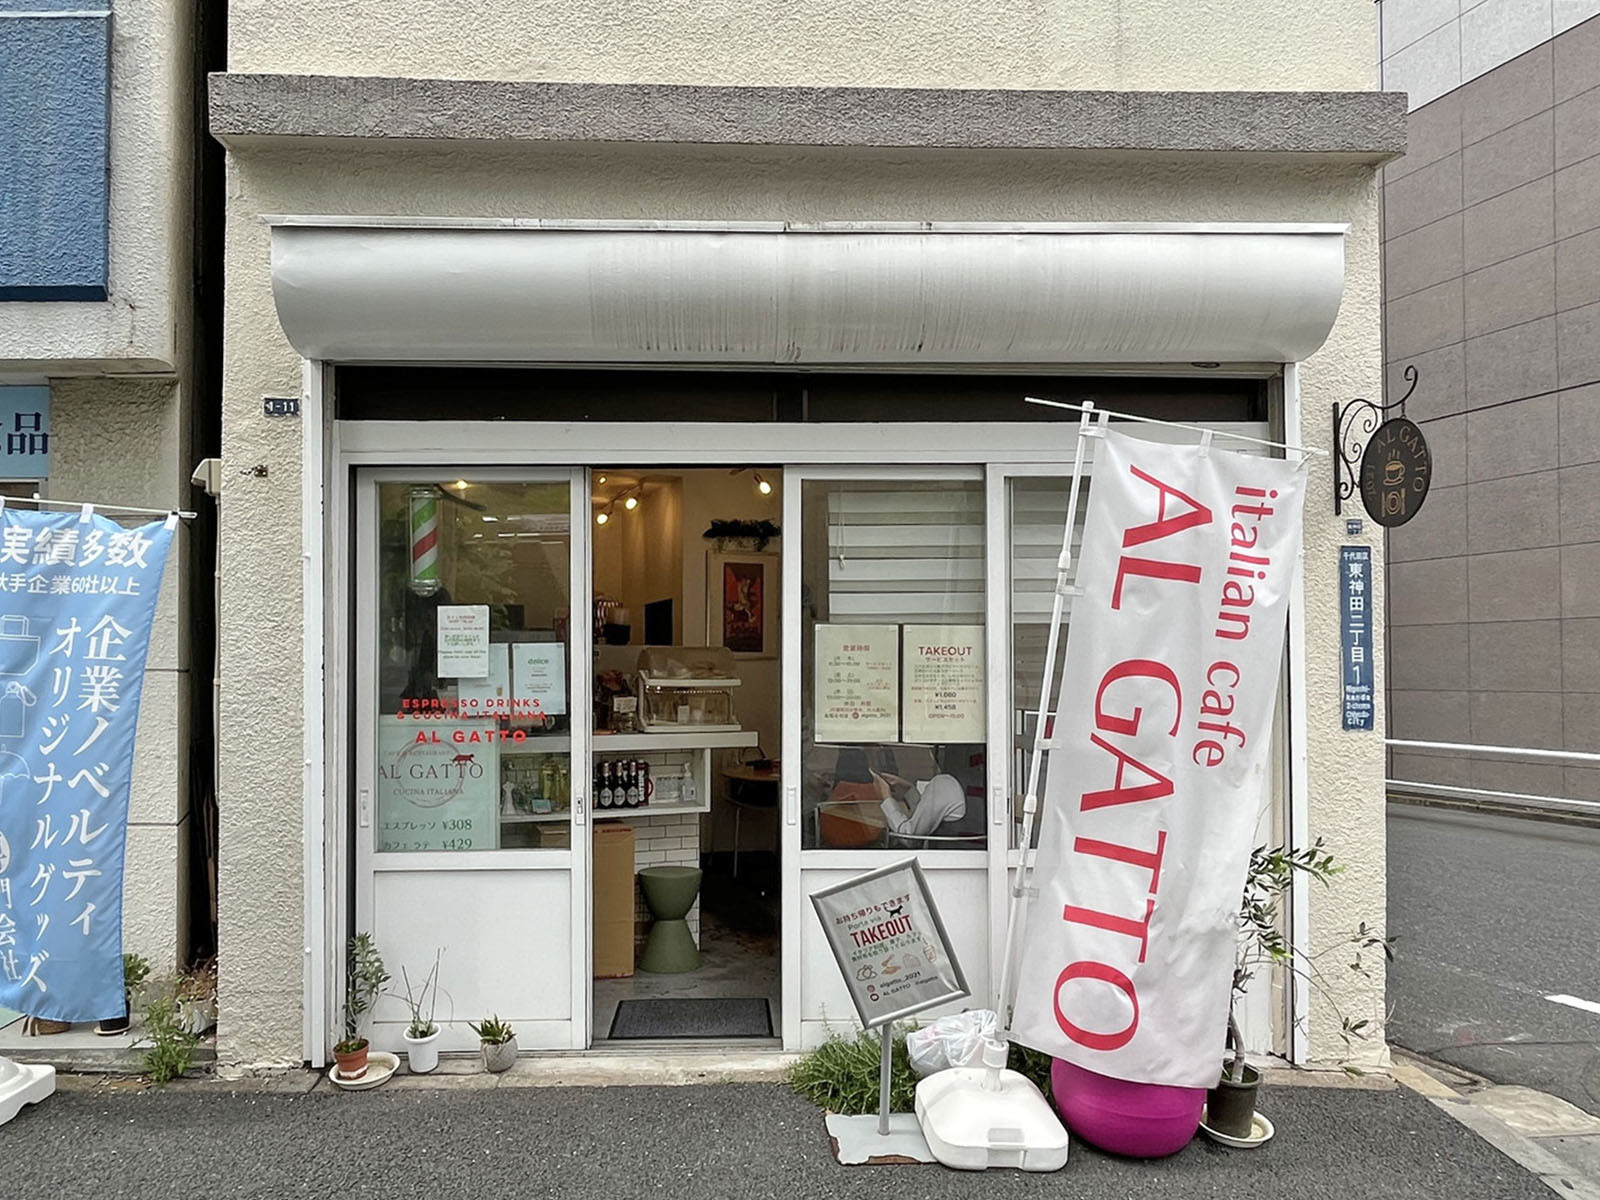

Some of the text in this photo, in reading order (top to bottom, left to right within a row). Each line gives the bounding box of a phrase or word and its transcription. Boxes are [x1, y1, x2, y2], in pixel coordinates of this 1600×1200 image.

[0, 411, 49, 456] 品
[1377, 425, 1427, 492] AL GATTO
[0, 524, 153, 569] 実績多数
[1192, 486, 1279, 768] italian cafe
[918, 646, 973, 656] TAKEOUT
[397, 711, 547, 720] & CUCINA ITALIANA
[402, 699, 541, 708] ESPRESSO DRINKS
[415, 730, 527, 744] AL GATTO
[378, 763, 484, 779] AL GATTO
[1052, 464, 1213, 1053] AL GATTO
[61, 614, 134, 936] 企業ノベルティ
[393, 788, 464, 796] CUCINA ITALIANA
[21, 617, 82, 993] オリジナルグッズ
[383, 818, 473, 831] エスプレッソ ¥308
[442, 838, 473, 850] ¥429
[849, 914, 913, 948] TAKEOUT
